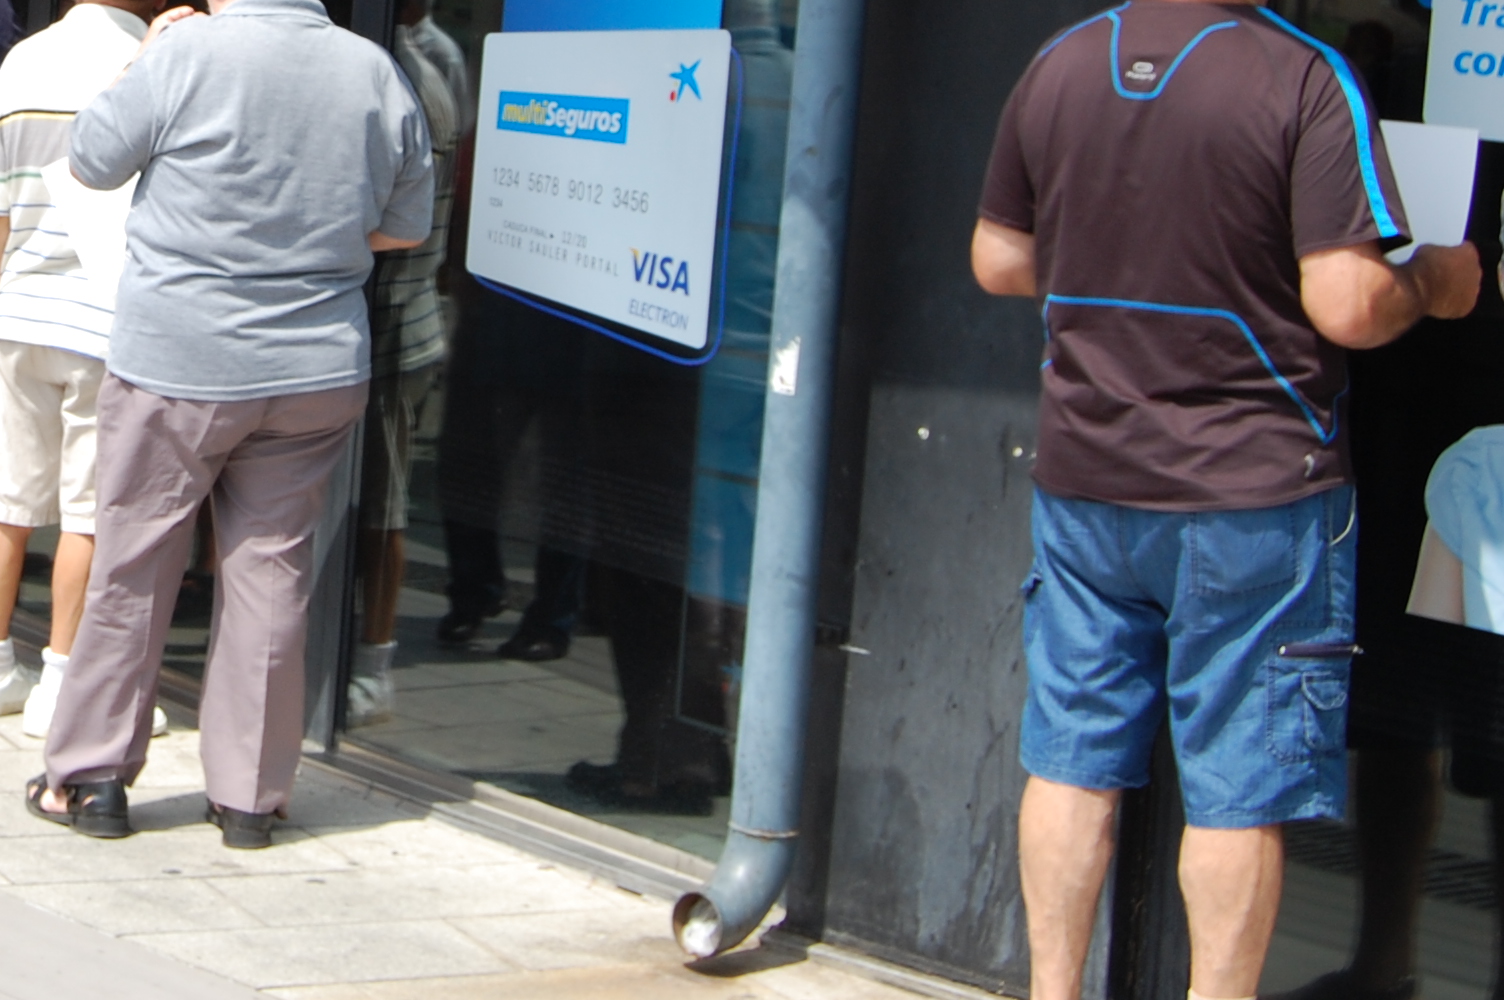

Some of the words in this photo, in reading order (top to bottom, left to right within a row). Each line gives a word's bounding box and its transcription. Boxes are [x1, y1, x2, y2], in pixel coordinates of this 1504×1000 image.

[502, 99, 622, 135] multiSeguros
[493, 167, 520, 188] 1234
[528, 172, 560, 197] 5678
[567, 179, 604, 205] 9012
[612, 187, 650, 214] 3456
[576, 252, 620, 277] PORTAL
[629, 247, 691, 297] VISA
[628, 299, 690, 331] ELECTRON
